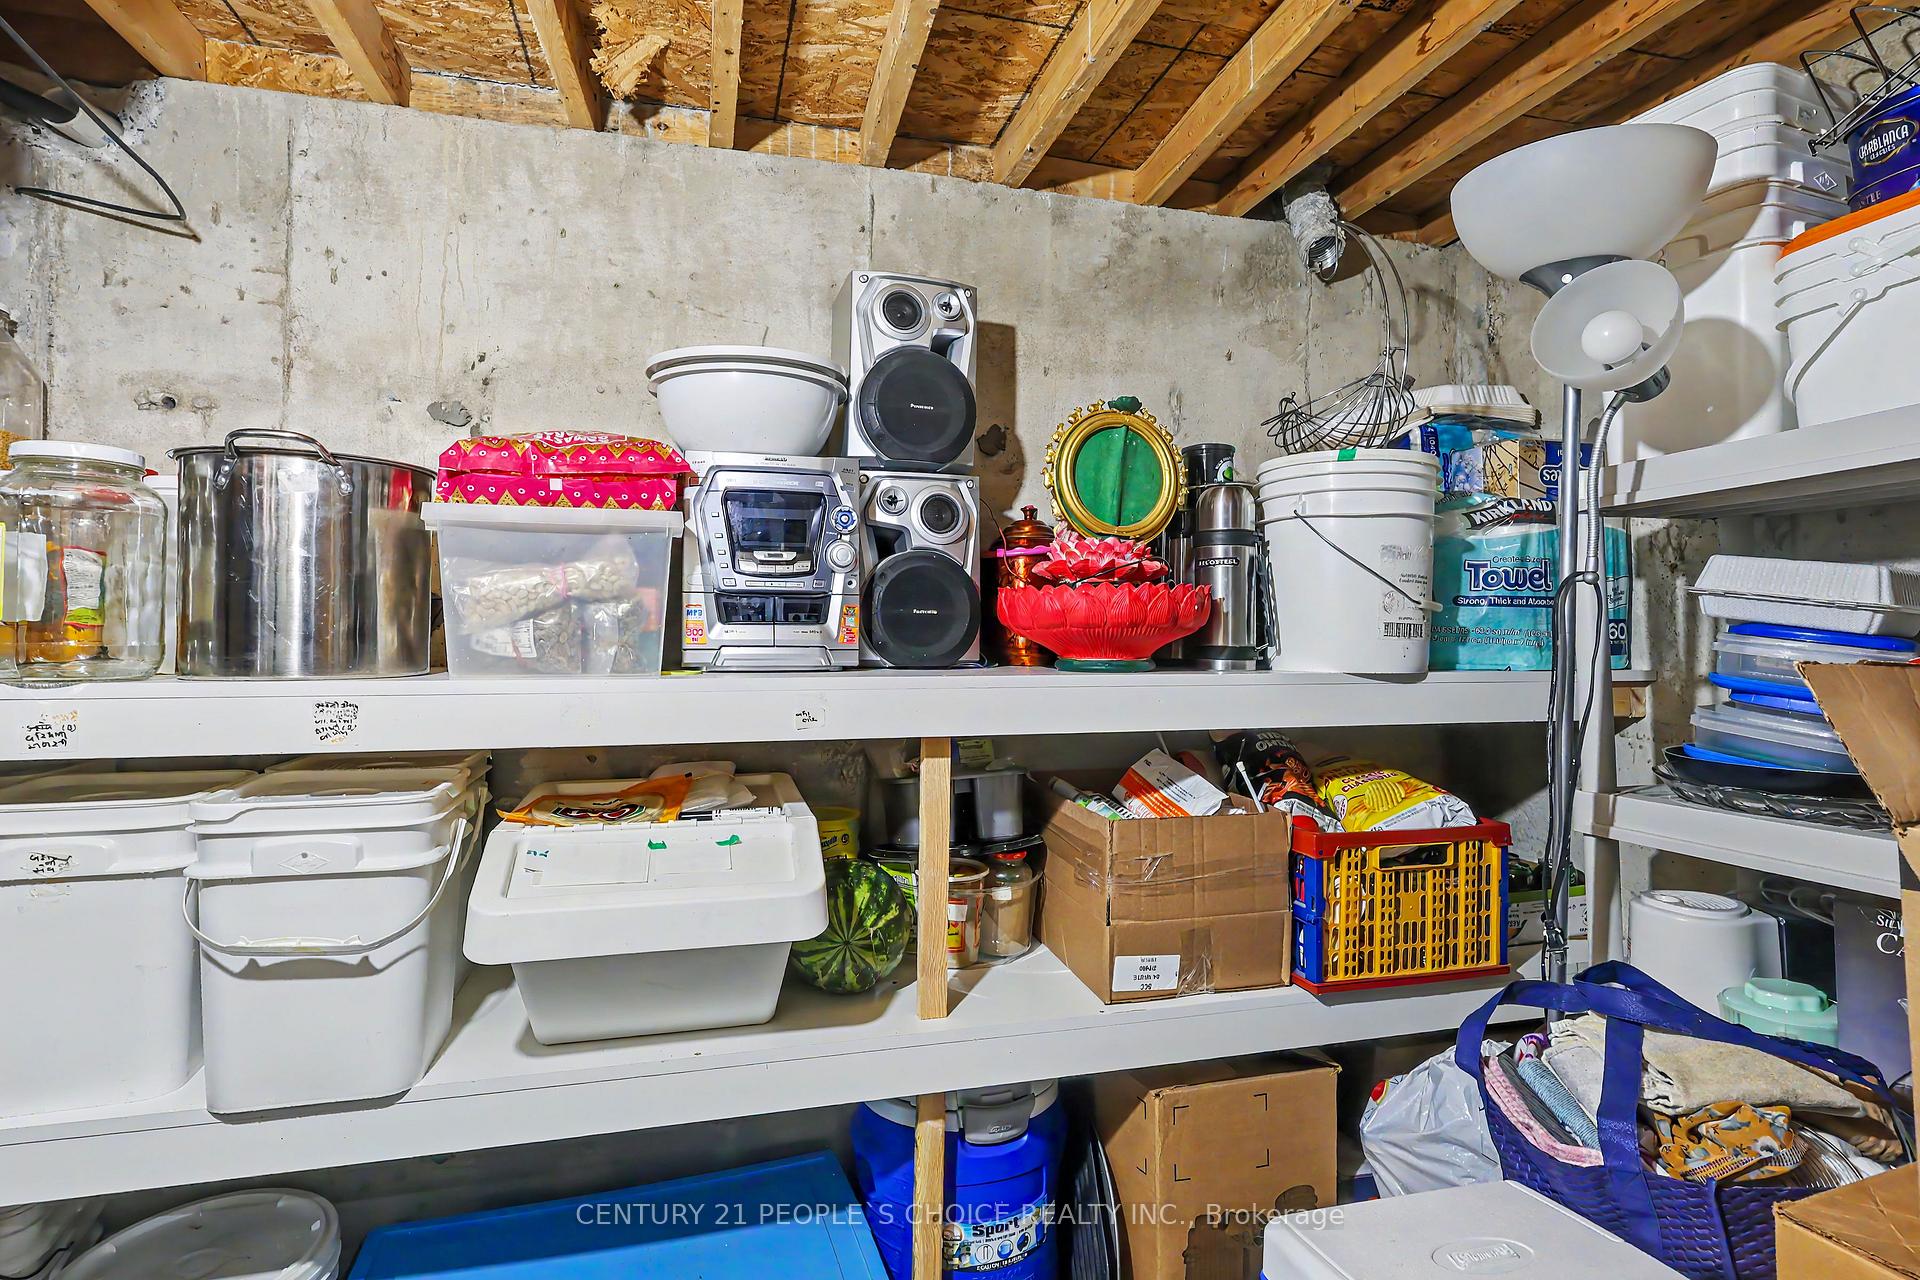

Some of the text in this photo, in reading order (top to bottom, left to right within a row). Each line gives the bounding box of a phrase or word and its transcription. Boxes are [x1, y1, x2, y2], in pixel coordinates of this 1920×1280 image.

[1470, 499, 1553, 525] KIRKLAND
[1464, 559, 1553, 591] Towel
[1457, 595, 1488, 607] Strong,
[1490, 595, 1511, 605] Thick
[1512, 597, 1527, 605] and
[971, 1216, 1021, 1238] Sport
